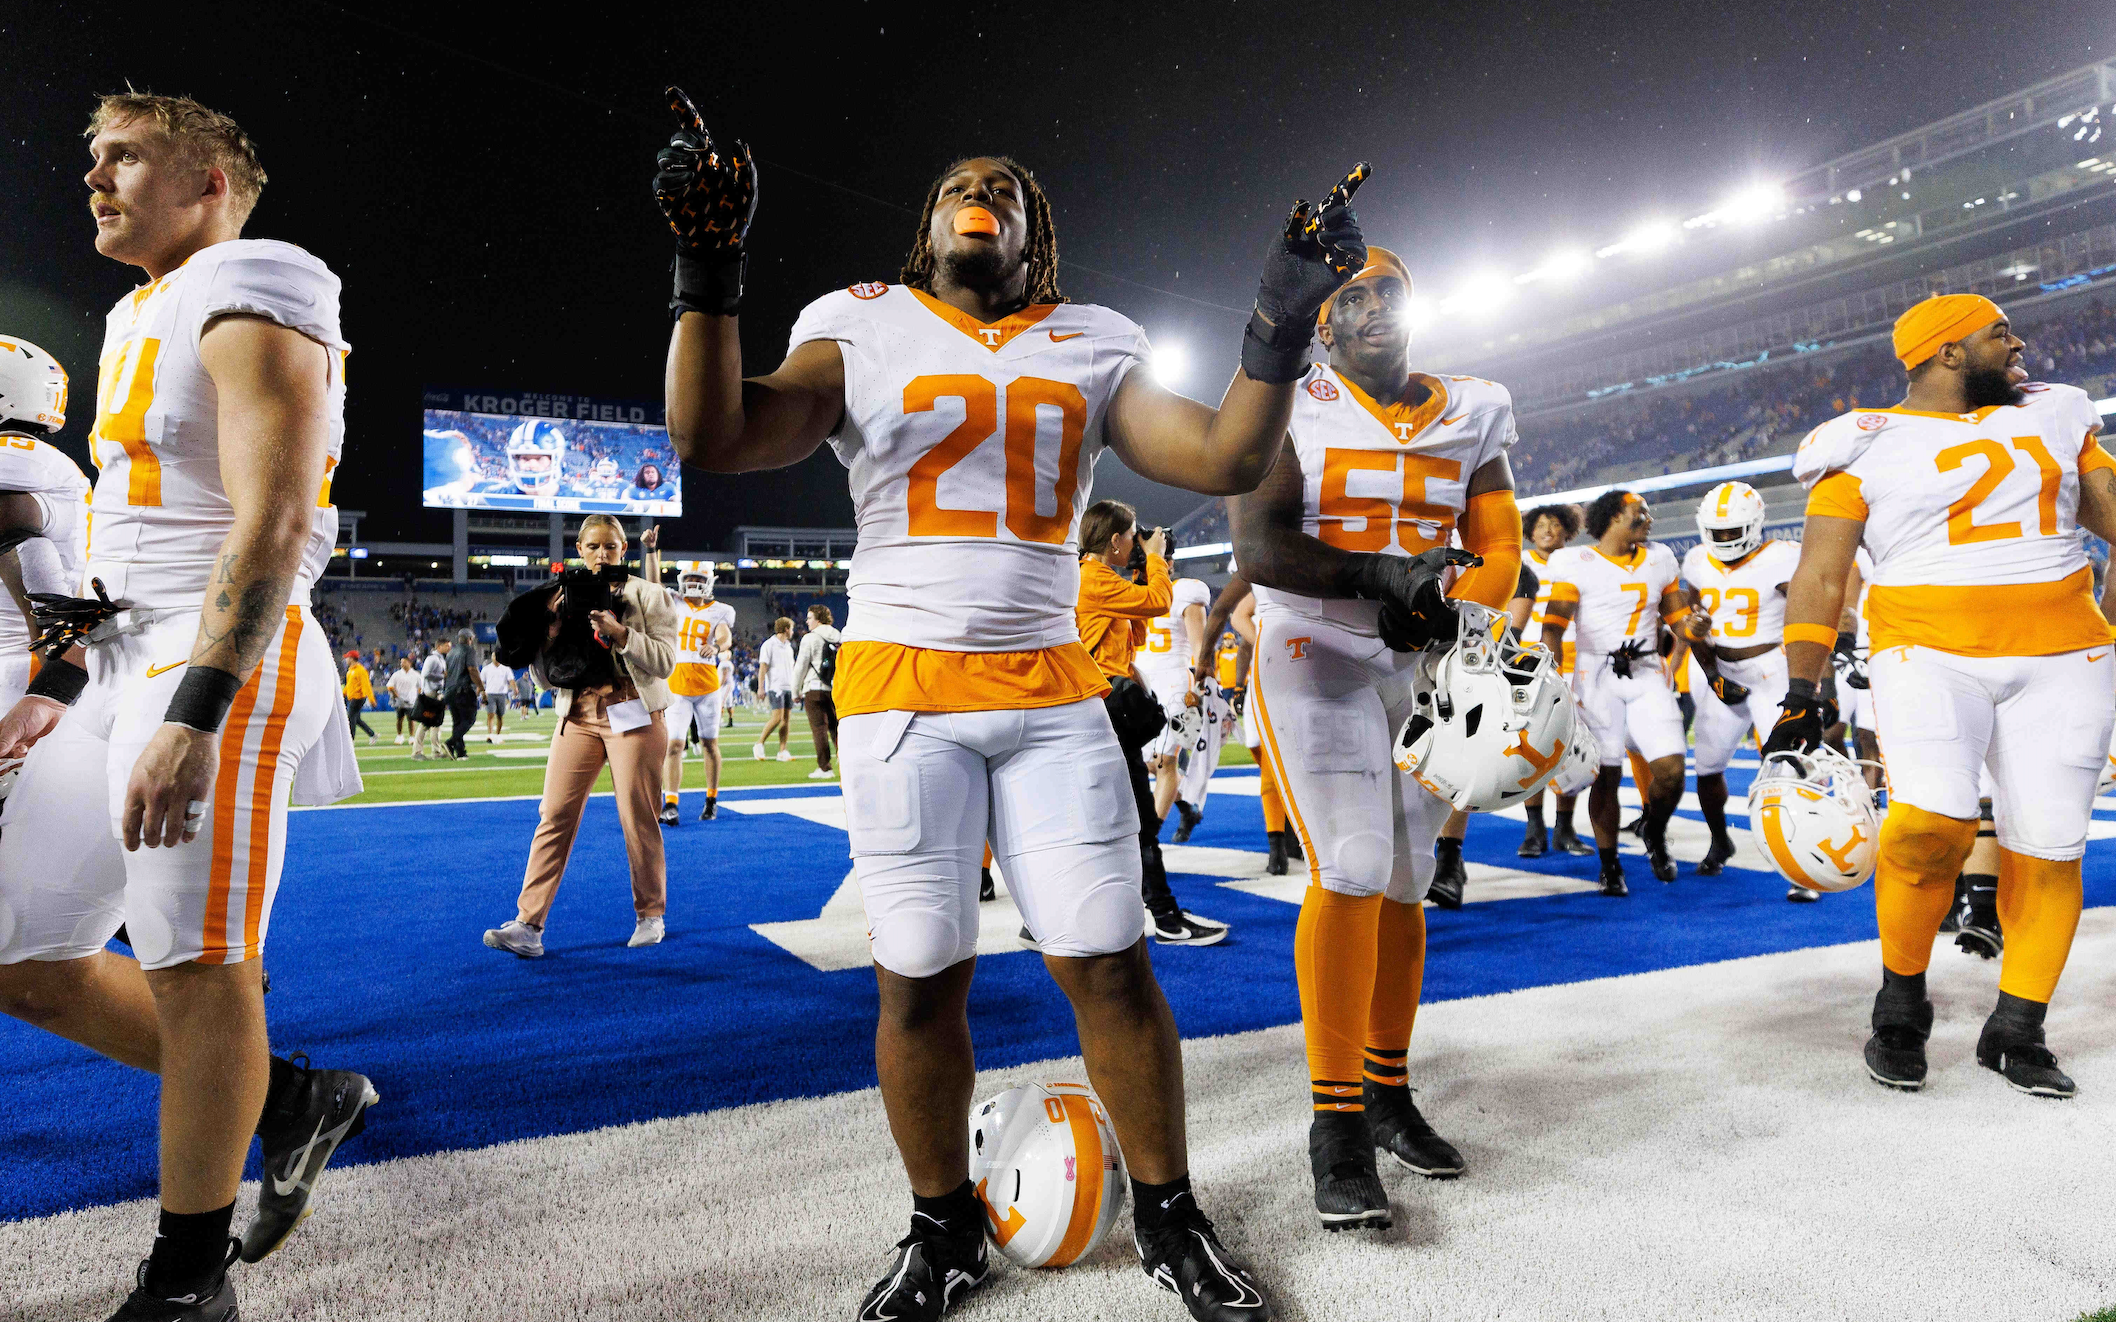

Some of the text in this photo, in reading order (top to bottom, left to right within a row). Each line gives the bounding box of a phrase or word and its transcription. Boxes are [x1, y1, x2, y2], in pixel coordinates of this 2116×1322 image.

[850, 283, 888, 298] SEC
[979, 328, 1001, 346] T
[464, 394, 645, 423] KROGER FIELD
[523, 392, 591, 404] WELCOME TO
[1312, 383, 1338, 400] SEC
[90, 337, 162, 506] 4
[1394, 422, 1413, 440] T
[903, 374, 1087, 545] 20
[1318, 447, 1462, 557] 55
[1934, 436, 2063, 546] 21
[217, 554, 240, 585] K
[1620, 582, 1648, 636] 7
[1700, 587, 1760, 638] 23
[679, 616, 711, 652] 18
[1136, 611, 1172, 653] 5
[1285, 636, 1312, 660] T
[1502, 728, 1565, 790] T
[1817, 825, 1867, 873] T
